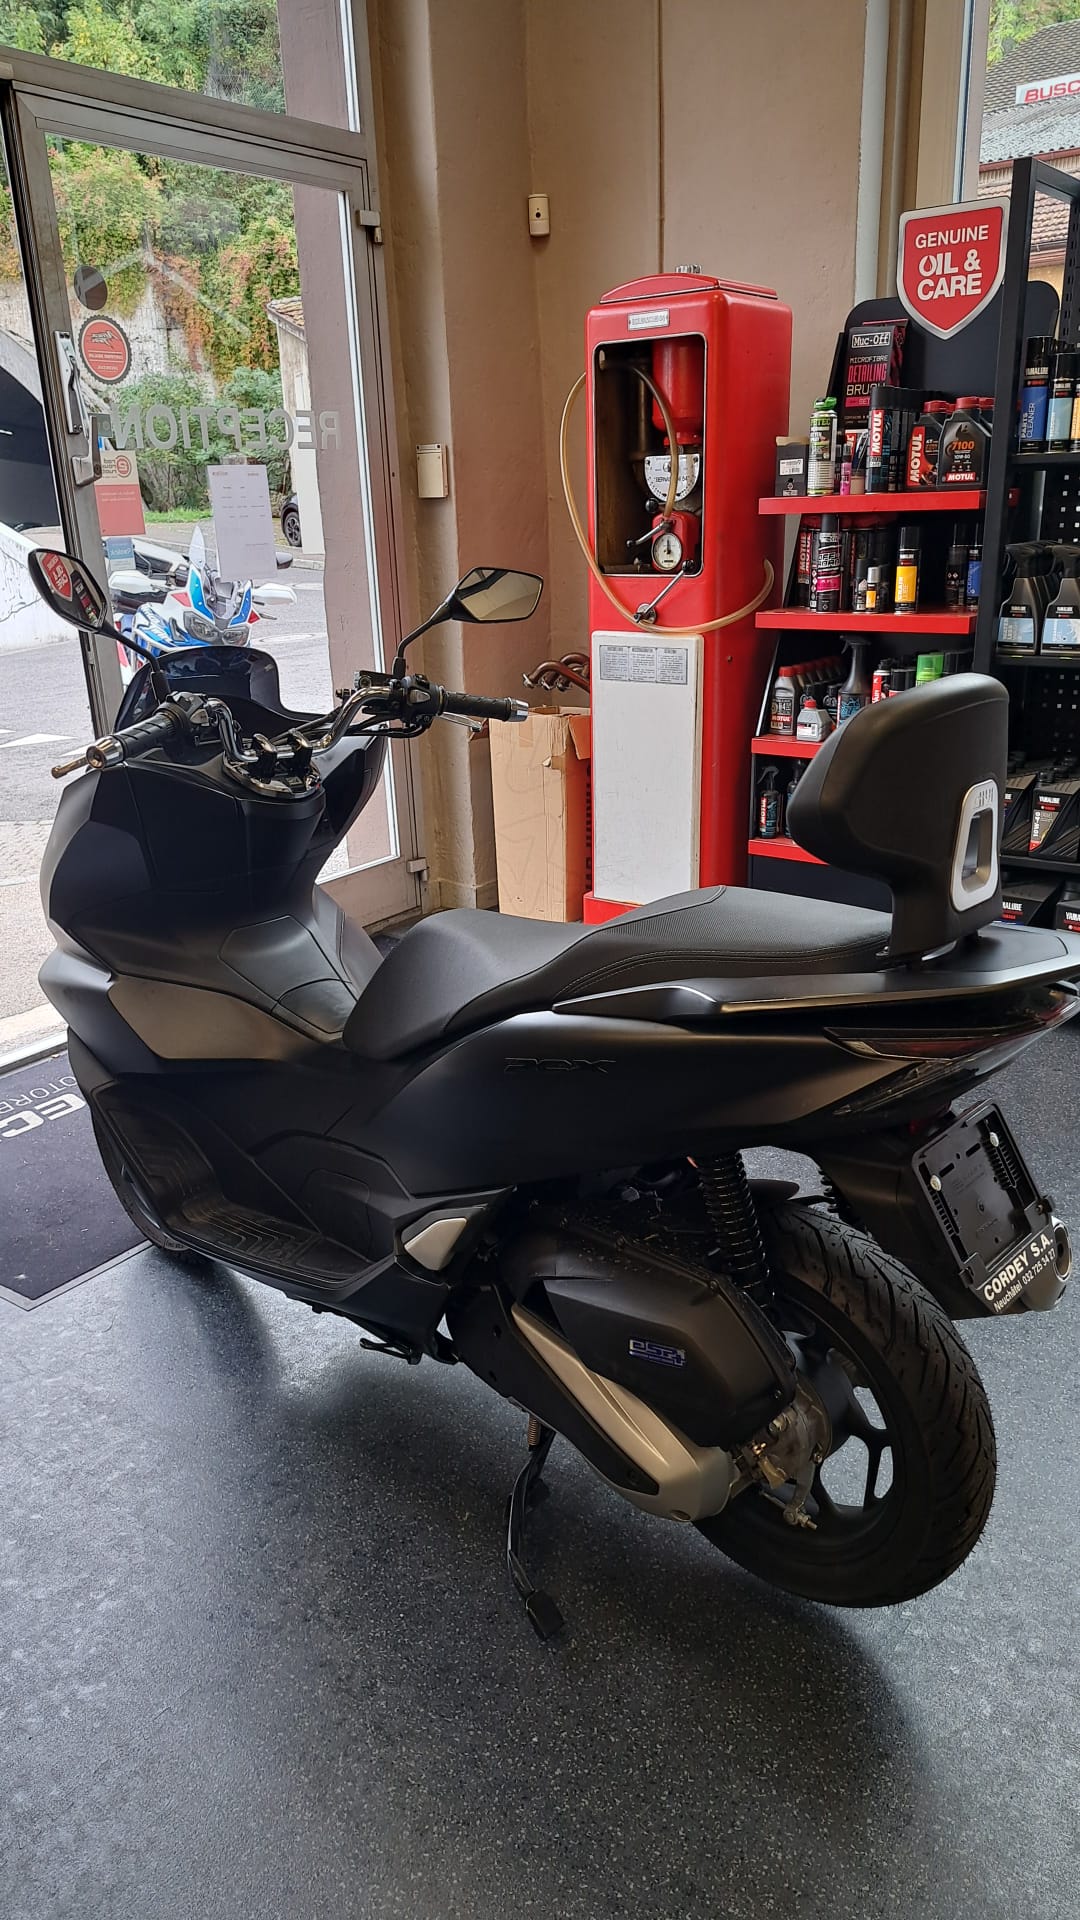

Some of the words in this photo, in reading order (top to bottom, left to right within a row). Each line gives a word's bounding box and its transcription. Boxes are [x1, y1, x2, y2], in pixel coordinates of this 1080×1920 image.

[915, 224, 989, 249] GENUINE
[918, 253, 958, 277] OIL
[964, 249, 981, 272] &
[917, 273, 982, 300] CARE
[854, 333, 889, 346] Muc-Off
[848, 363, 887, 383] DETAILING
[872, 411, 882, 454] MOTUL
[952, 441, 975, 450] 7100
[910, 434, 922, 483] MOTUL
[947, 473, 974, 481] MOTUL
[984, 1250, 1029, 1301] CORDEY
[1030, 1233, 1053, 1257] S.A.
[1022, 1270, 1034, 1285] 032
